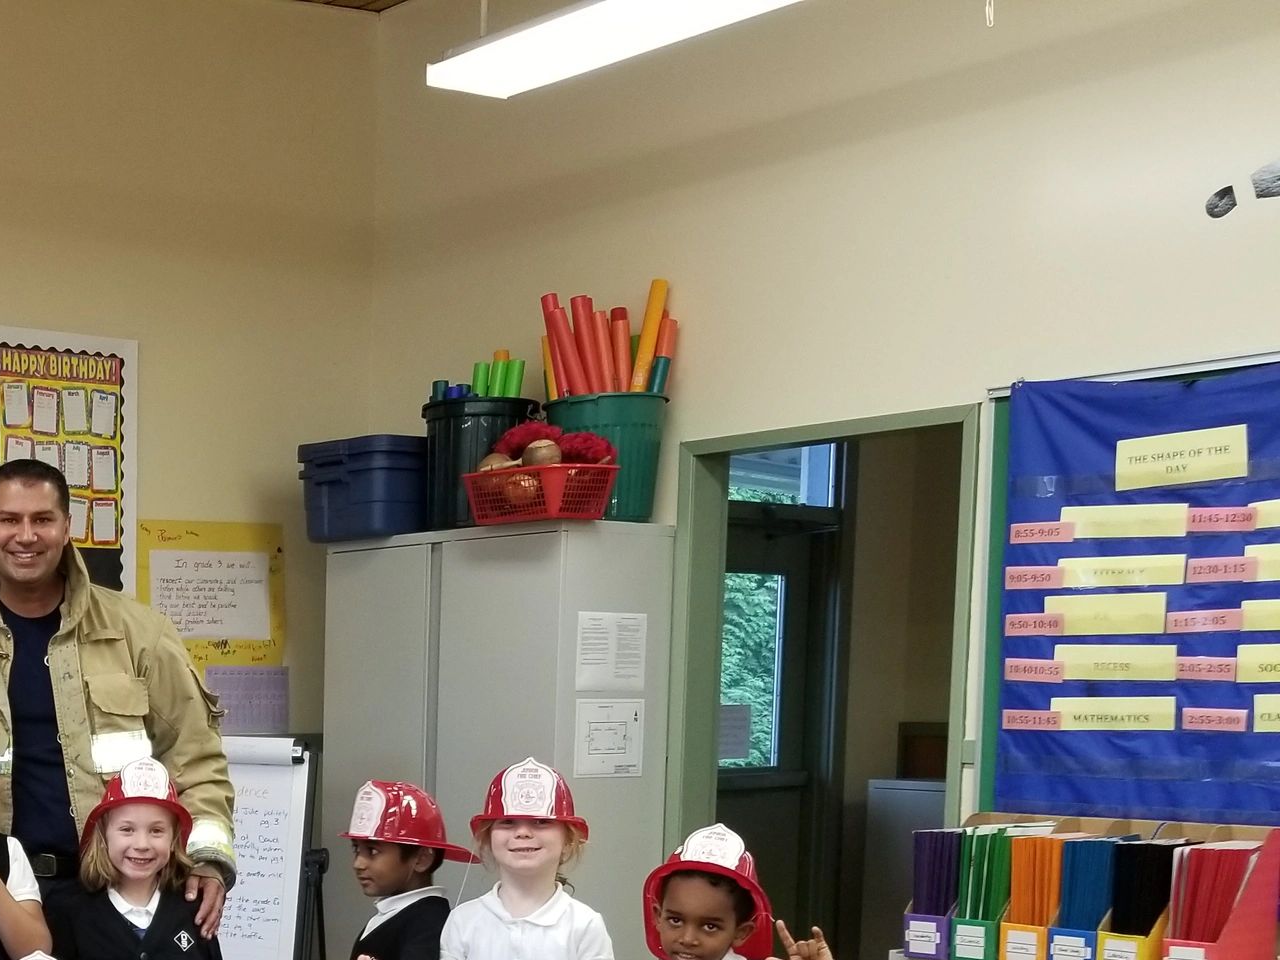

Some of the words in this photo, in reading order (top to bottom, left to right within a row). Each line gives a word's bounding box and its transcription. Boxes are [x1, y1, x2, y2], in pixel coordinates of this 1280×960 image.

[1, 349, 46, 377] HAPPY
[48, 354, 117, 382] BIRTHDAY!
[36, 391, 54, 400] February
[1127, 455, 1149, 466] THE
[1150, 451, 1186, 464] SHAPE
[1188, 449, 1205, 459] OF
[1207, 444, 1231, 456] THE
[1165, 463, 1189, 475] DAY
[1191, 512, 1253, 525] 11:45-12:30
[1014, 527, 1060, 539] 8:55-9:05
[174, 559, 187, 569] In
[193, 559, 214, 572] grade
[217, 560, 223, 569] 3
[1192, 563, 1247, 576] 12:30-1:15
[1008, 573, 1052, 584] 9:05-9:50
[1008, 619, 1058, 630] 9:50-10:40
[1173, 615, 1227, 628] 1:15-2:05
[1093, 661, 1131, 672] RECESS
[1178, 662, 1231, 674] 2:05-2:55
[1006, 714, 1057, 726] 10:55-11:45
[1073, 713, 1150, 724] MATHEMATICS
[1187, 715, 1241, 727] 2:55-3:00
[274, 817, 280, 826] 3
